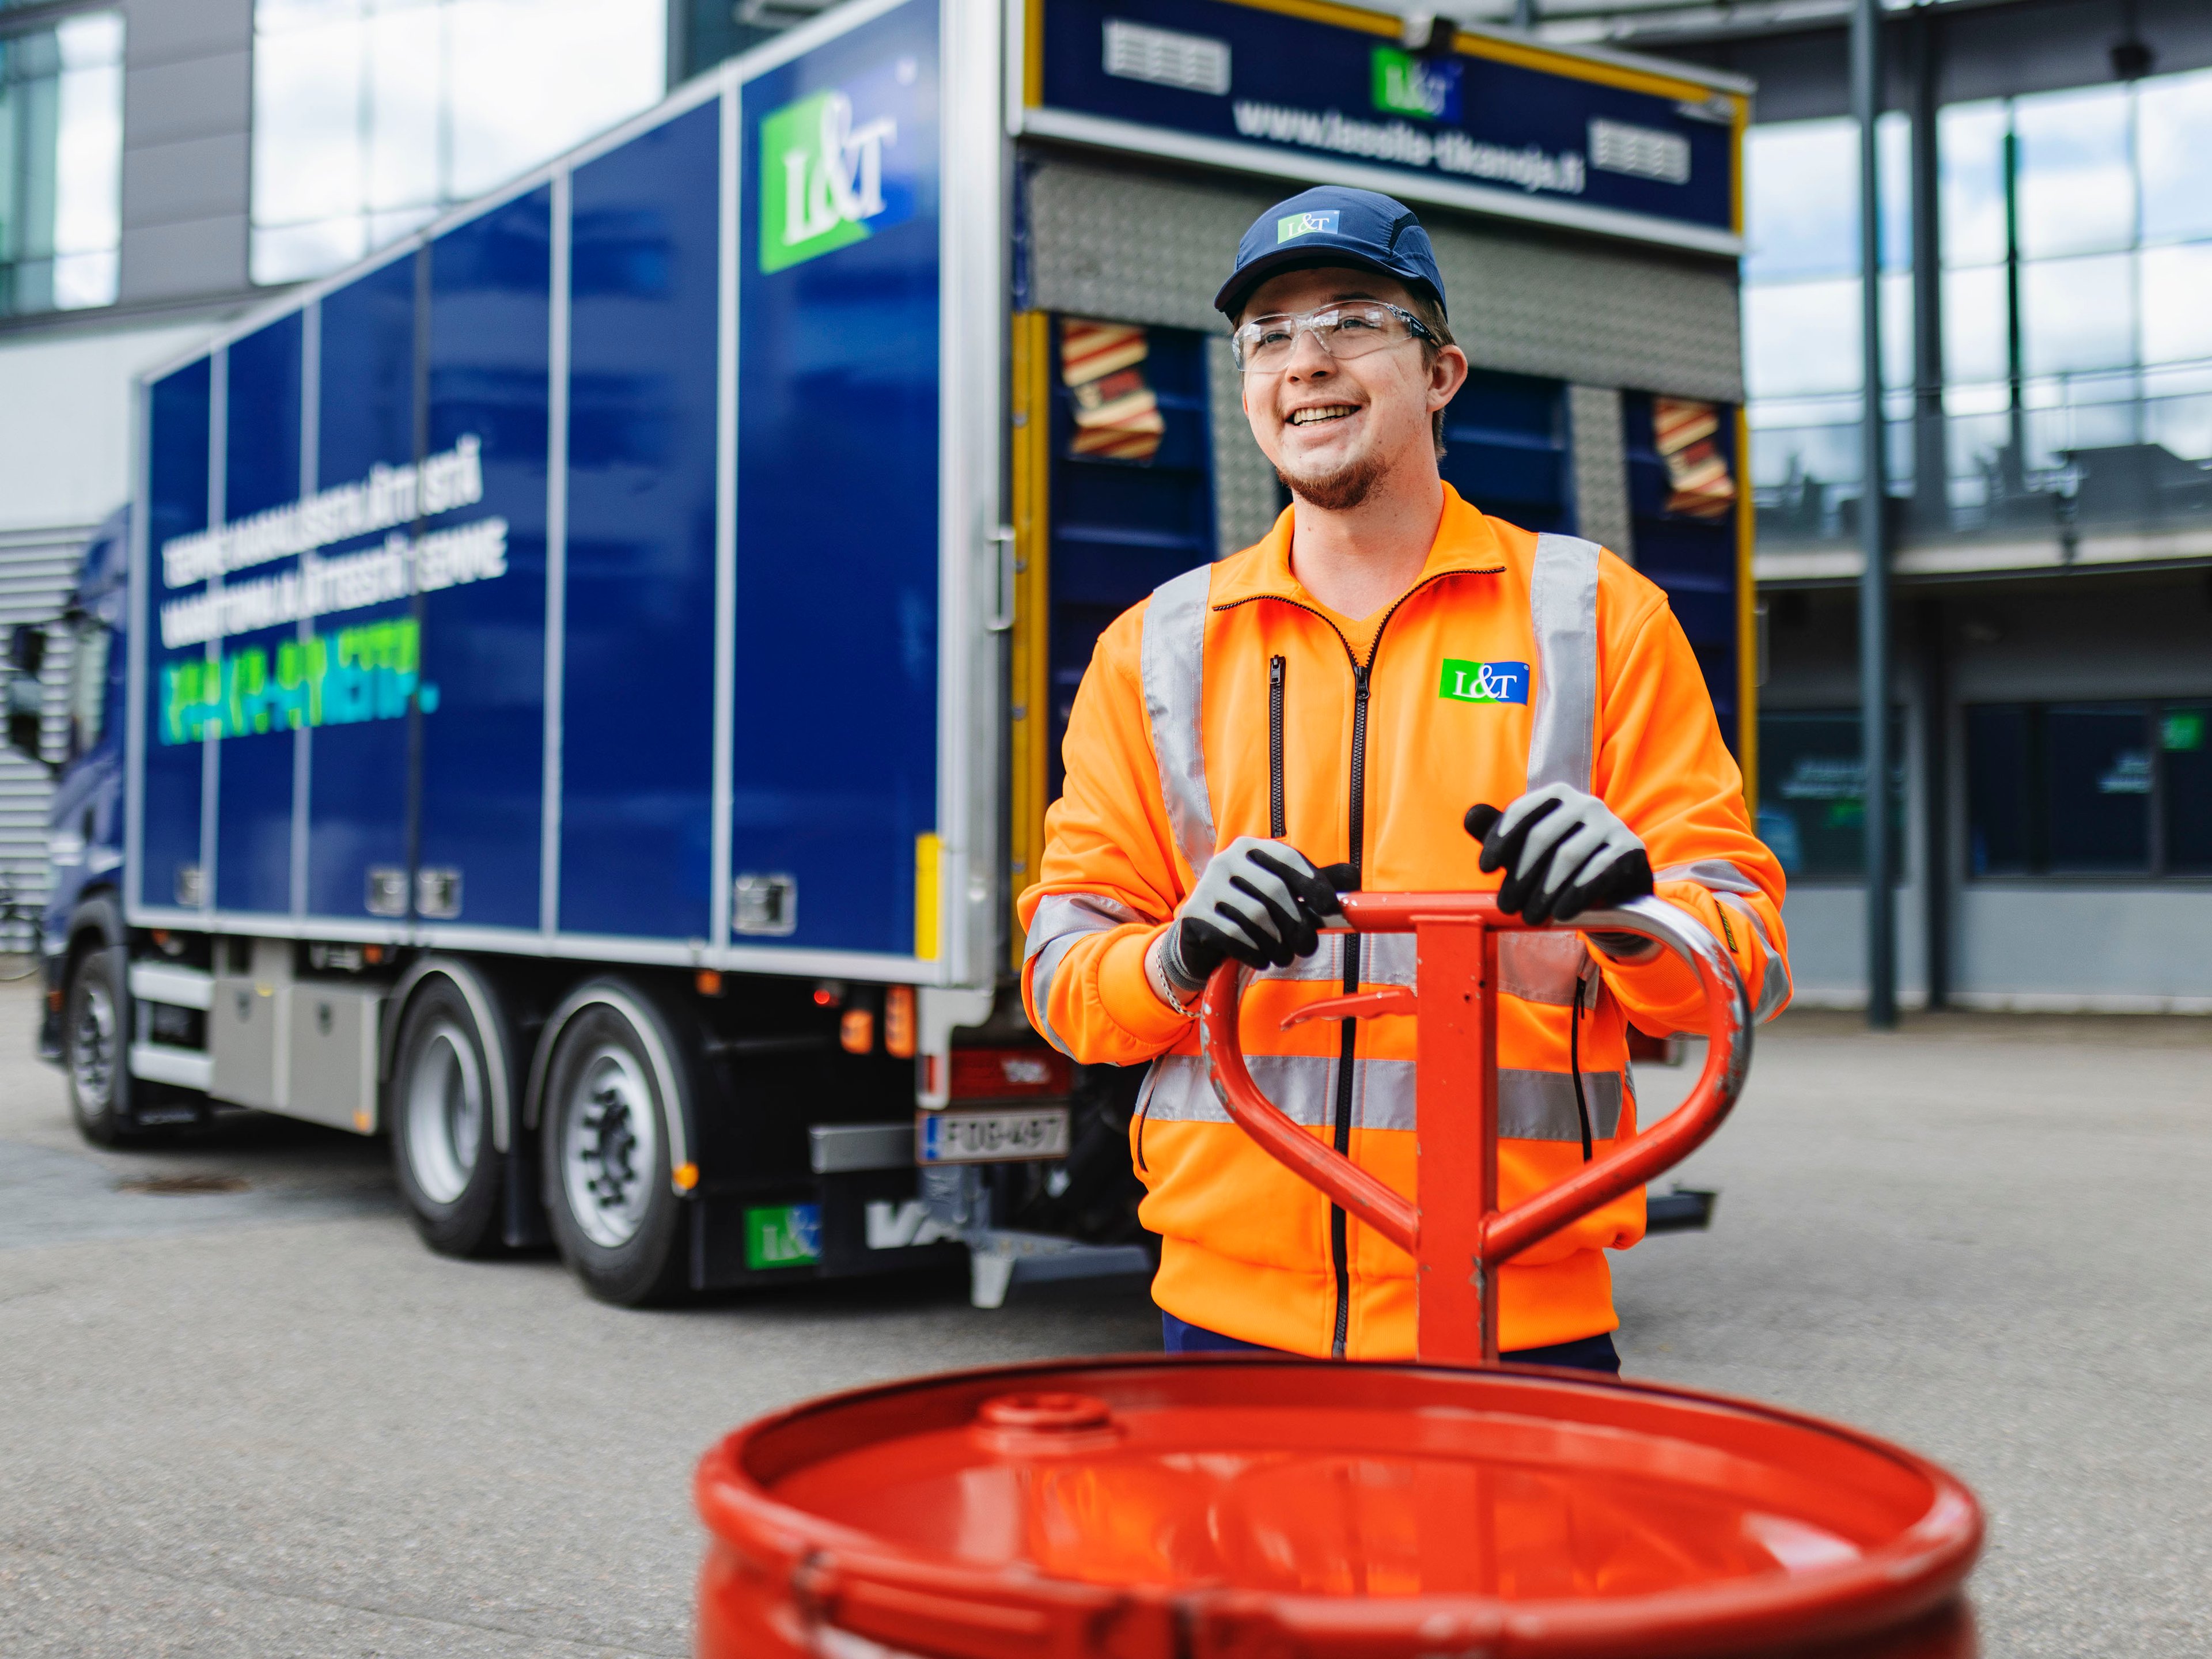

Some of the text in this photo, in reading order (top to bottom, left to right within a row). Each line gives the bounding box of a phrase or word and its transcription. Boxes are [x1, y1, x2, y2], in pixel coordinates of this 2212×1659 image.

[780, 90, 897, 247] L&T
[1286, 213, 1330, 238] L&T
[1452, 664, 1517, 699] L&T
